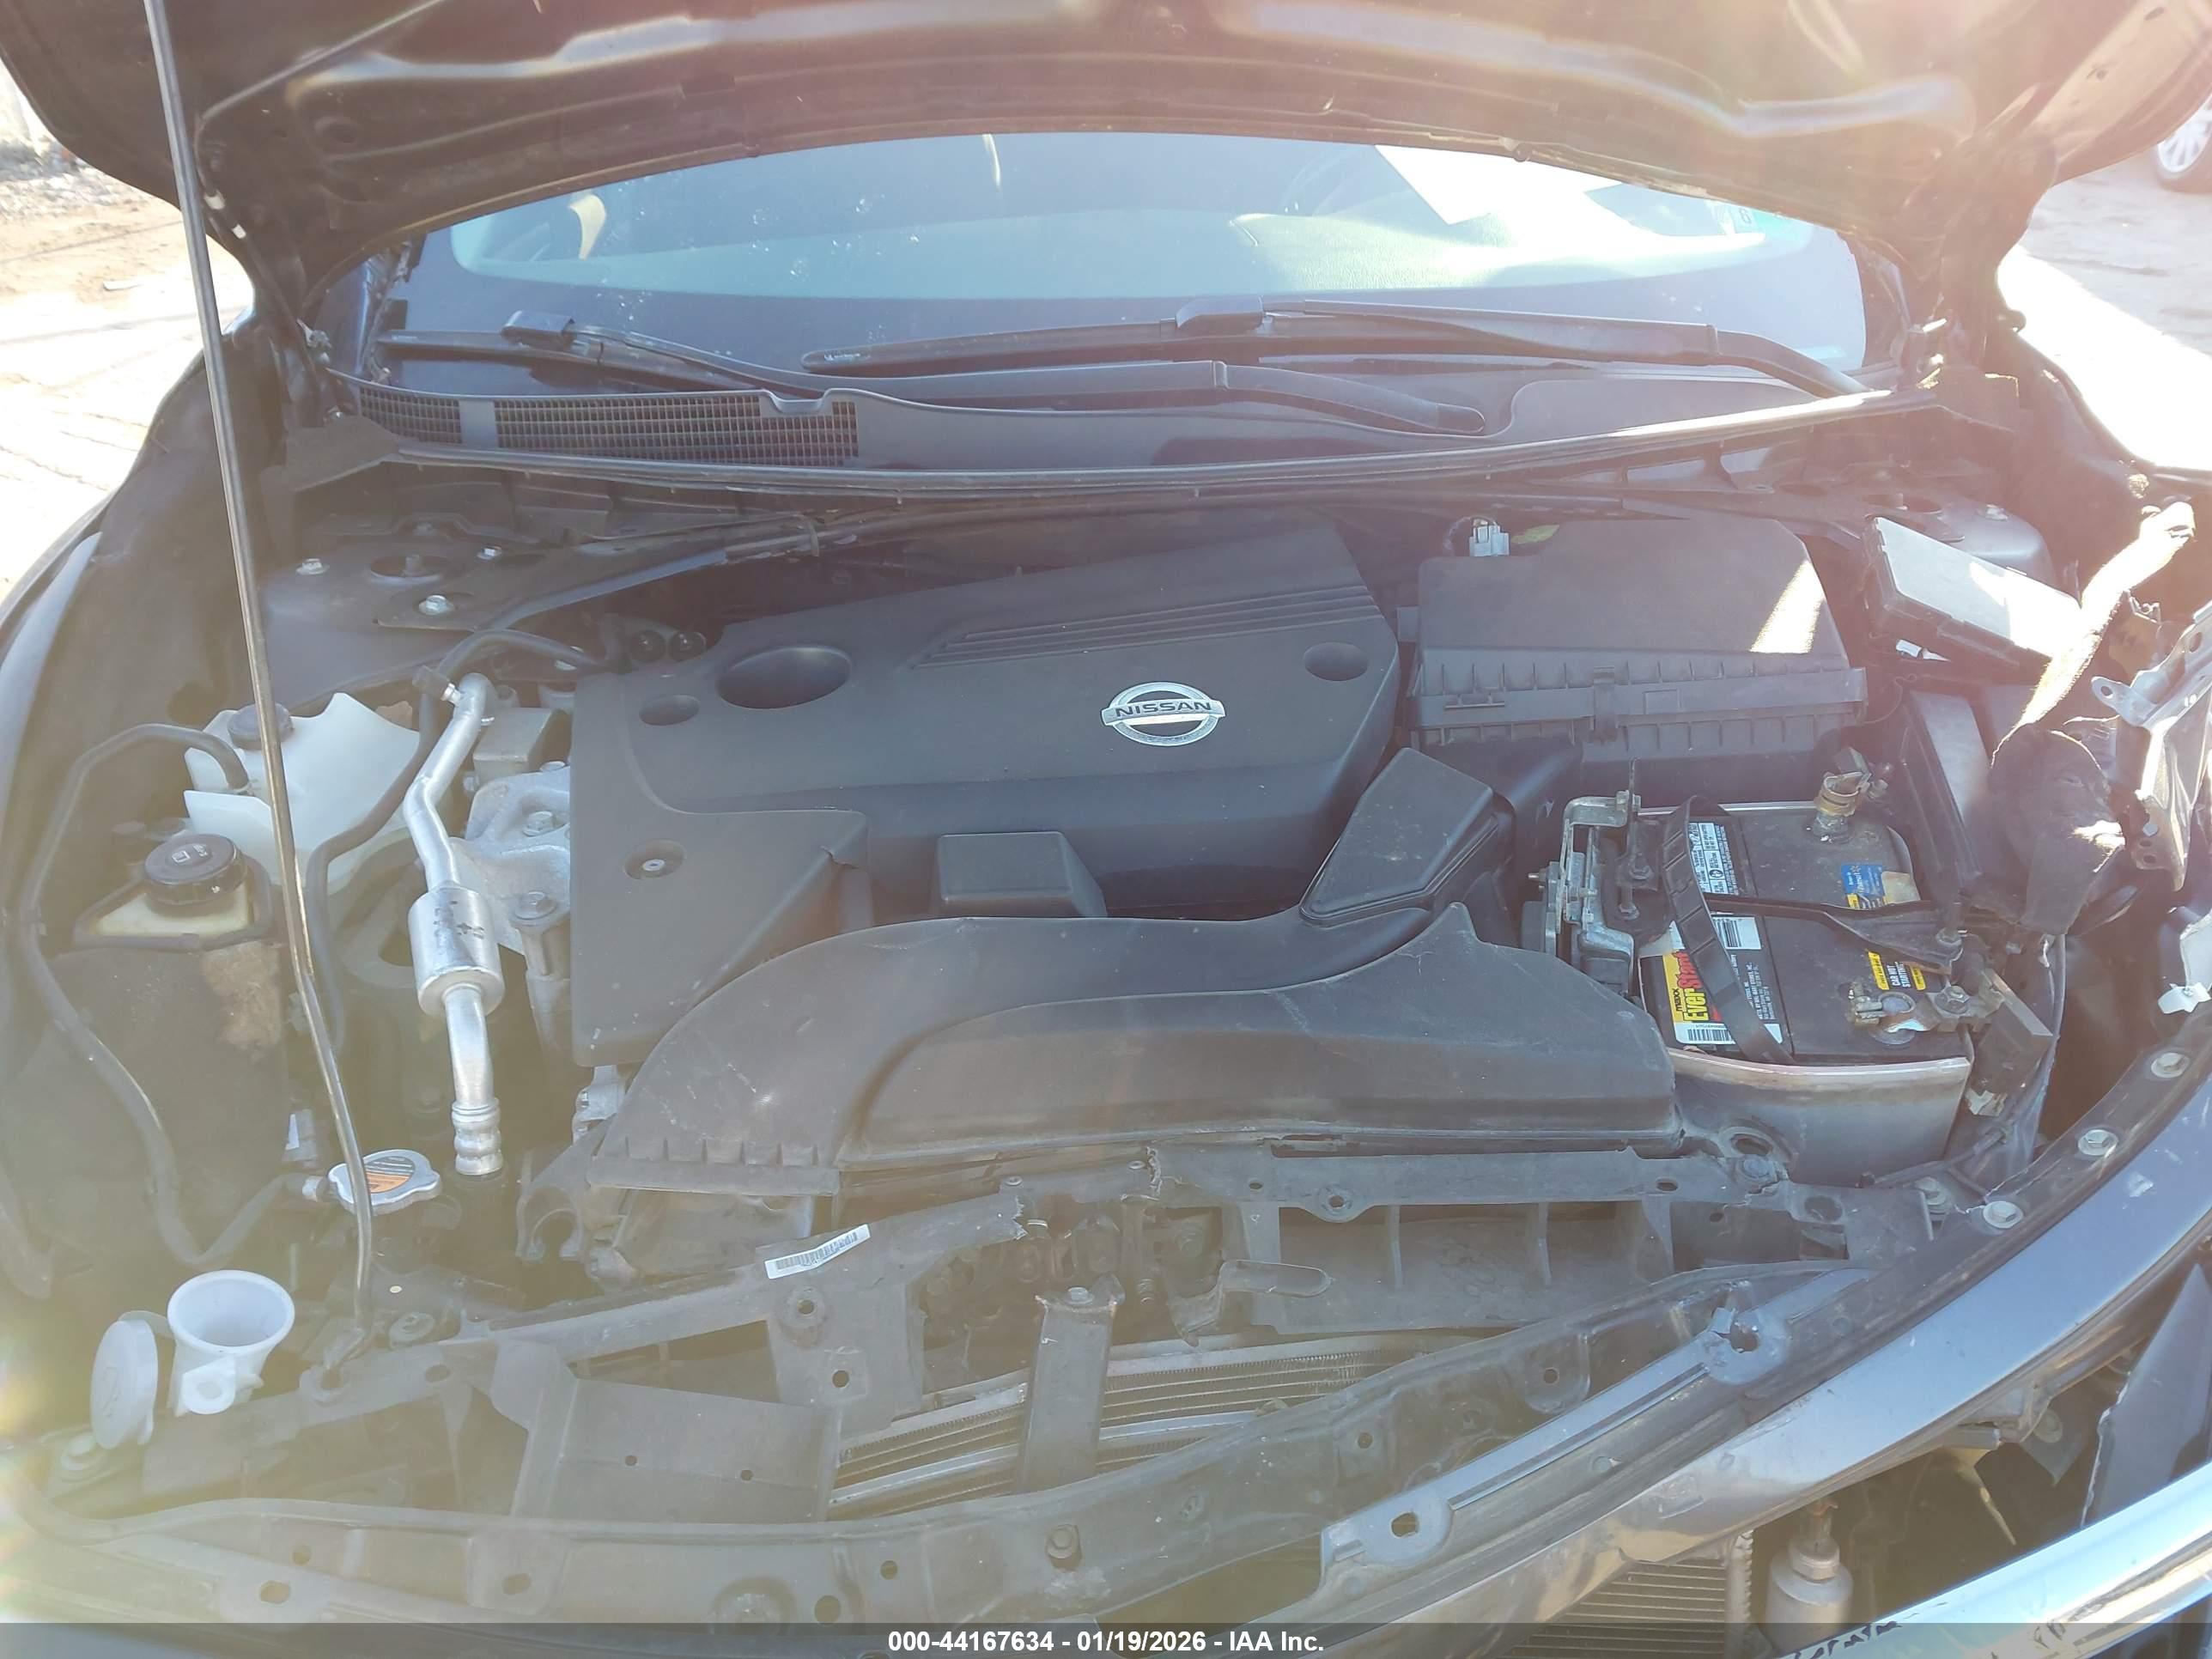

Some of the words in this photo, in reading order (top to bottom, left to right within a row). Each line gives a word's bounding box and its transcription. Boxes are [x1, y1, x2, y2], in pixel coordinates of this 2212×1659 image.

[1116, 702, 1211, 717] NISSAN
[1890, 975, 1900, 987] CAR
[1673, 988, 1682, 1012] maxx
